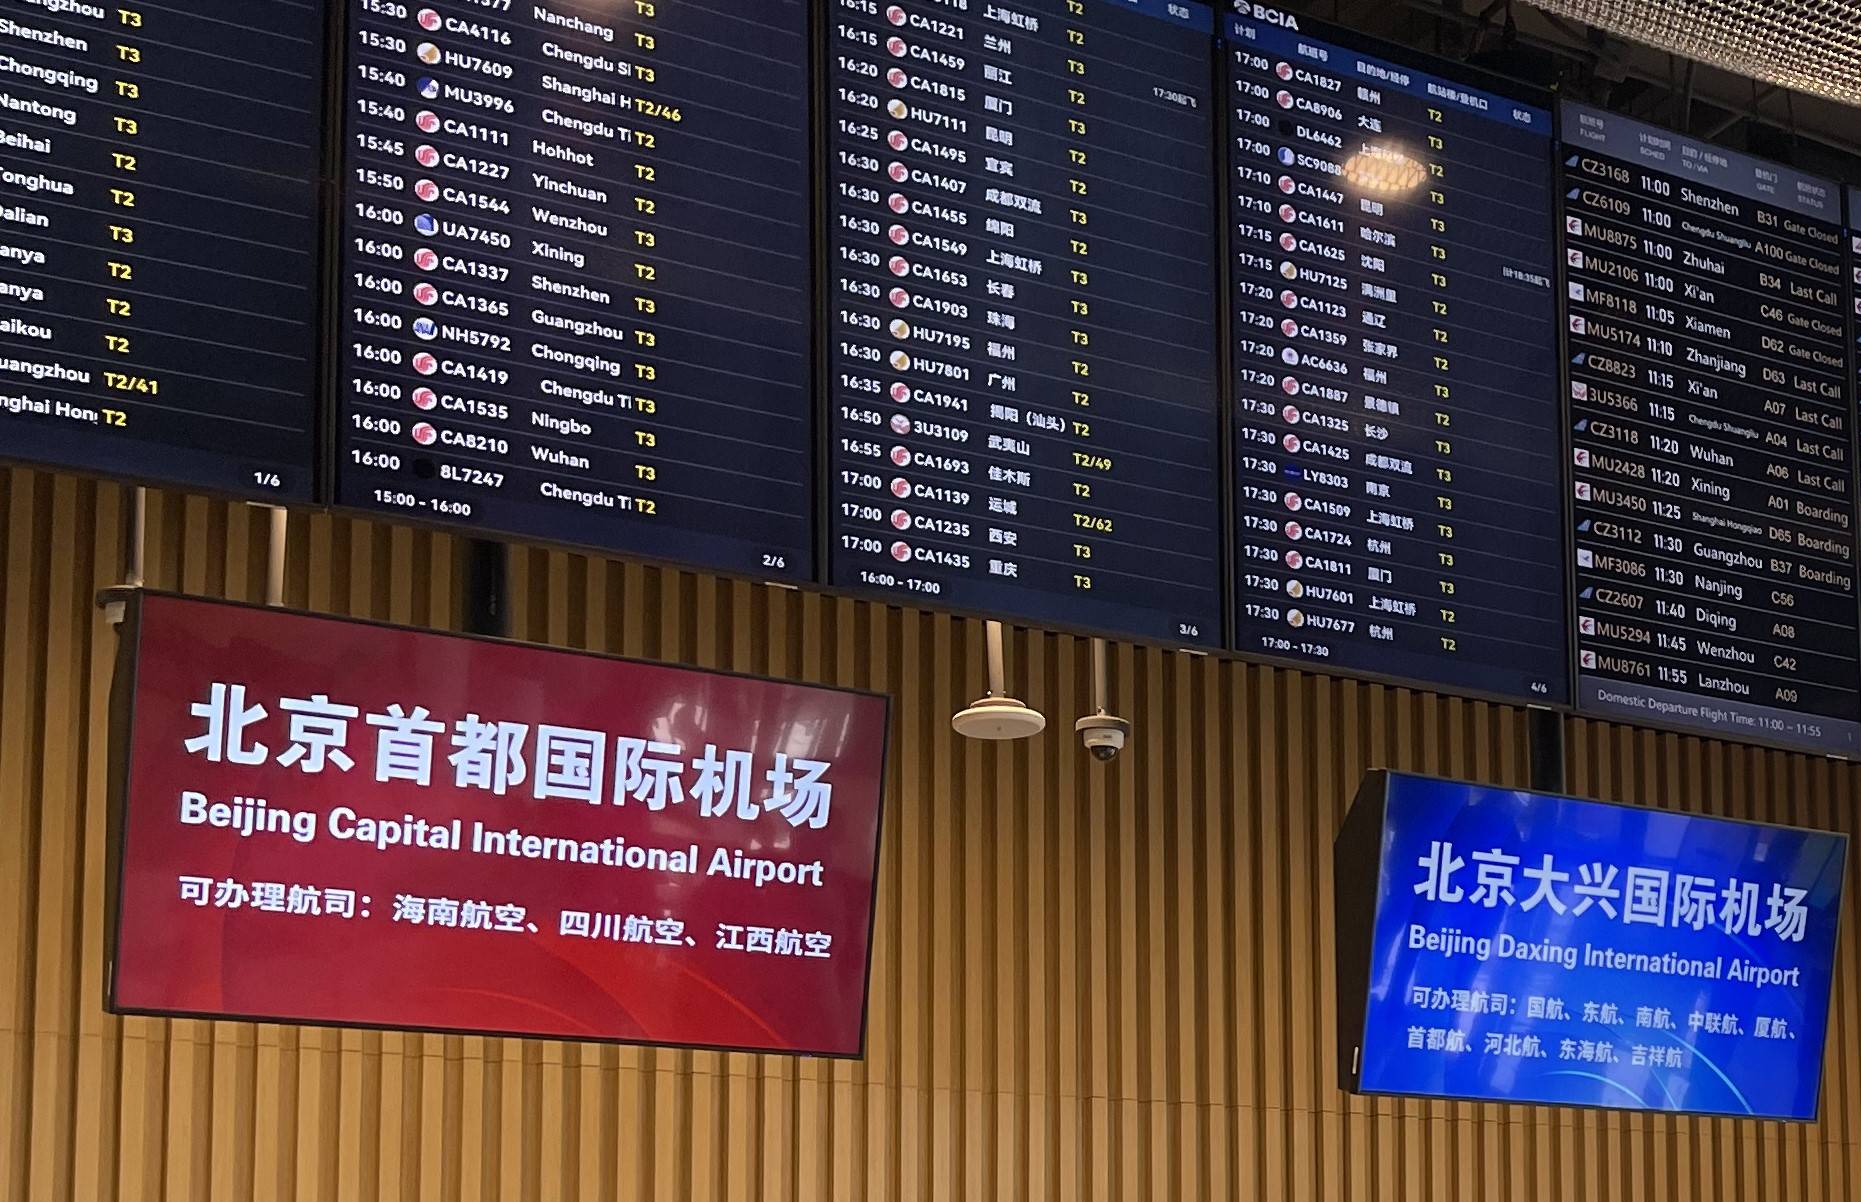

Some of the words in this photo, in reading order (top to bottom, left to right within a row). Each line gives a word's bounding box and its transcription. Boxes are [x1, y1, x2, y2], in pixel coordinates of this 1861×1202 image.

[0, 19, 87, 51] Shenzhen
[116, 45, 140, 62] T3
[1254, 4, 1298, 30] BCIA
[0, 56, 98, 93] Chongqing
[116, 81, 139, 98] T3
[838, 25, 877, 45] 16:15
[911, 46, 964, 70] CA1459
[1068, 90, 1085, 104] T2
[839, 57, 878, 77] 16:20
[911, 77, 965, 101] CA1815
[1069, 120, 1085, 134] T3
[358, 100, 404, 121] 15:40
[444, 120, 507, 146] CA1111
[533, 140, 593, 166] Hohhot
[635, 165, 655, 181] T2
[1236, 80, 1269, 98] 17:00
[1296, 98, 1342, 120] CA8906
[1358, 115, 1381, 132] 大连
[1428, 136, 1442, 149] T3
[357, 134, 404, 155] 15:45
[444, 154, 509, 179] CA1227
[533, 173, 606, 202] Yinchuan
[635, 198, 655, 214] T2
[1582, 157, 1630, 184] CZ3168
[1642, 176, 1669, 196] 11:00
[1681, 188, 1739, 216] Shenzhen
[1757, 211, 1777, 227] B31
[1784, 220, 1805, 235] Gate
[1808, 227, 1838, 244] Closed
[357, 169, 403, 190] 15:50
[443, 188, 509, 214] CA1544
[532, 207, 607, 236] Wenzhou
[635, 231, 654, 246] T3
[356, 203, 403, 224] 16:00
[443, 222, 510, 248] UA7450
[532, 241, 584, 267] Xining
[635, 264, 655, 280] T2
[1239, 224, 1271, 241] 17:15
[1299, 240, 1345, 260] CA1625
[1432, 274, 1446, 286] T3
[841, 311, 880, 329] 16:30
[914, 326, 970, 349] HU7195
[1072, 362, 1088, 375] T2
[104, 372, 157, 394] T2/41
[353, 379, 401, 399] 16:00
[441, 395, 508, 419] CA1535
[532, 412, 591, 434] Ningbo
[635, 431, 655, 446] T3
[841, 407, 881, 425] 16:50
[914, 421, 968, 442] 3U3109
[1073, 453, 1111, 470] T2/49
[1242, 399, 1275, 415] 17:30
[1303, 412, 1348, 431] CA1325
[1436, 441, 1450, 453] T3
[254, 472, 280, 486] 1/6
[763, 555, 784, 567] 2/6
[842, 503, 881, 520] 17:00
[915, 516, 969, 536] CA1235
[989, 528, 1017, 546] 西安
[1074, 544, 1090, 558] T3
[1594, 522, 1641, 543] CZ3112
[1654, 534, 1682, 552] 11:30
[1694, 543, 1763, 570] Guangzhou
[1771, 559, 1792, 574] B37
[1799, 565, 1851, 590] Boarding
[1180, 624, 1198, 636] 3/6
[1246, 604, 1279, 620] 17:30
[1307, 615, 1354, 632] HU7677
[1441, 638, 1455, 650] T2
[1597, 622, 1650, 644] MU5294
[1658, 633, 1686, 651] 11:45
[1697, 641, 1754, 664] Wenzhou
[1774, 656, 1796, 670] C42
[1531, 683, 1547, 693] 4/6
[184, 682, 833, 830] 北京首都国际机场
[181, 792, 317, 843] Beijing
[328, 807, 461, 852] Capital
[472, 822, 698, 875] International
[707, 847, 825, 888] Airport
[1414, 841, 1809, 942] 北京大兴国际机场
[1409, 924, 1491, 961] Beijing
[1498, 934, 1577, 970] Daxing
[1585, 944, 1722, 980] International
[1727, 960, 1800, 988] Airport
[1407, 1026, 1683, 1069] 首都航、河北航、东海航、吉祥航
